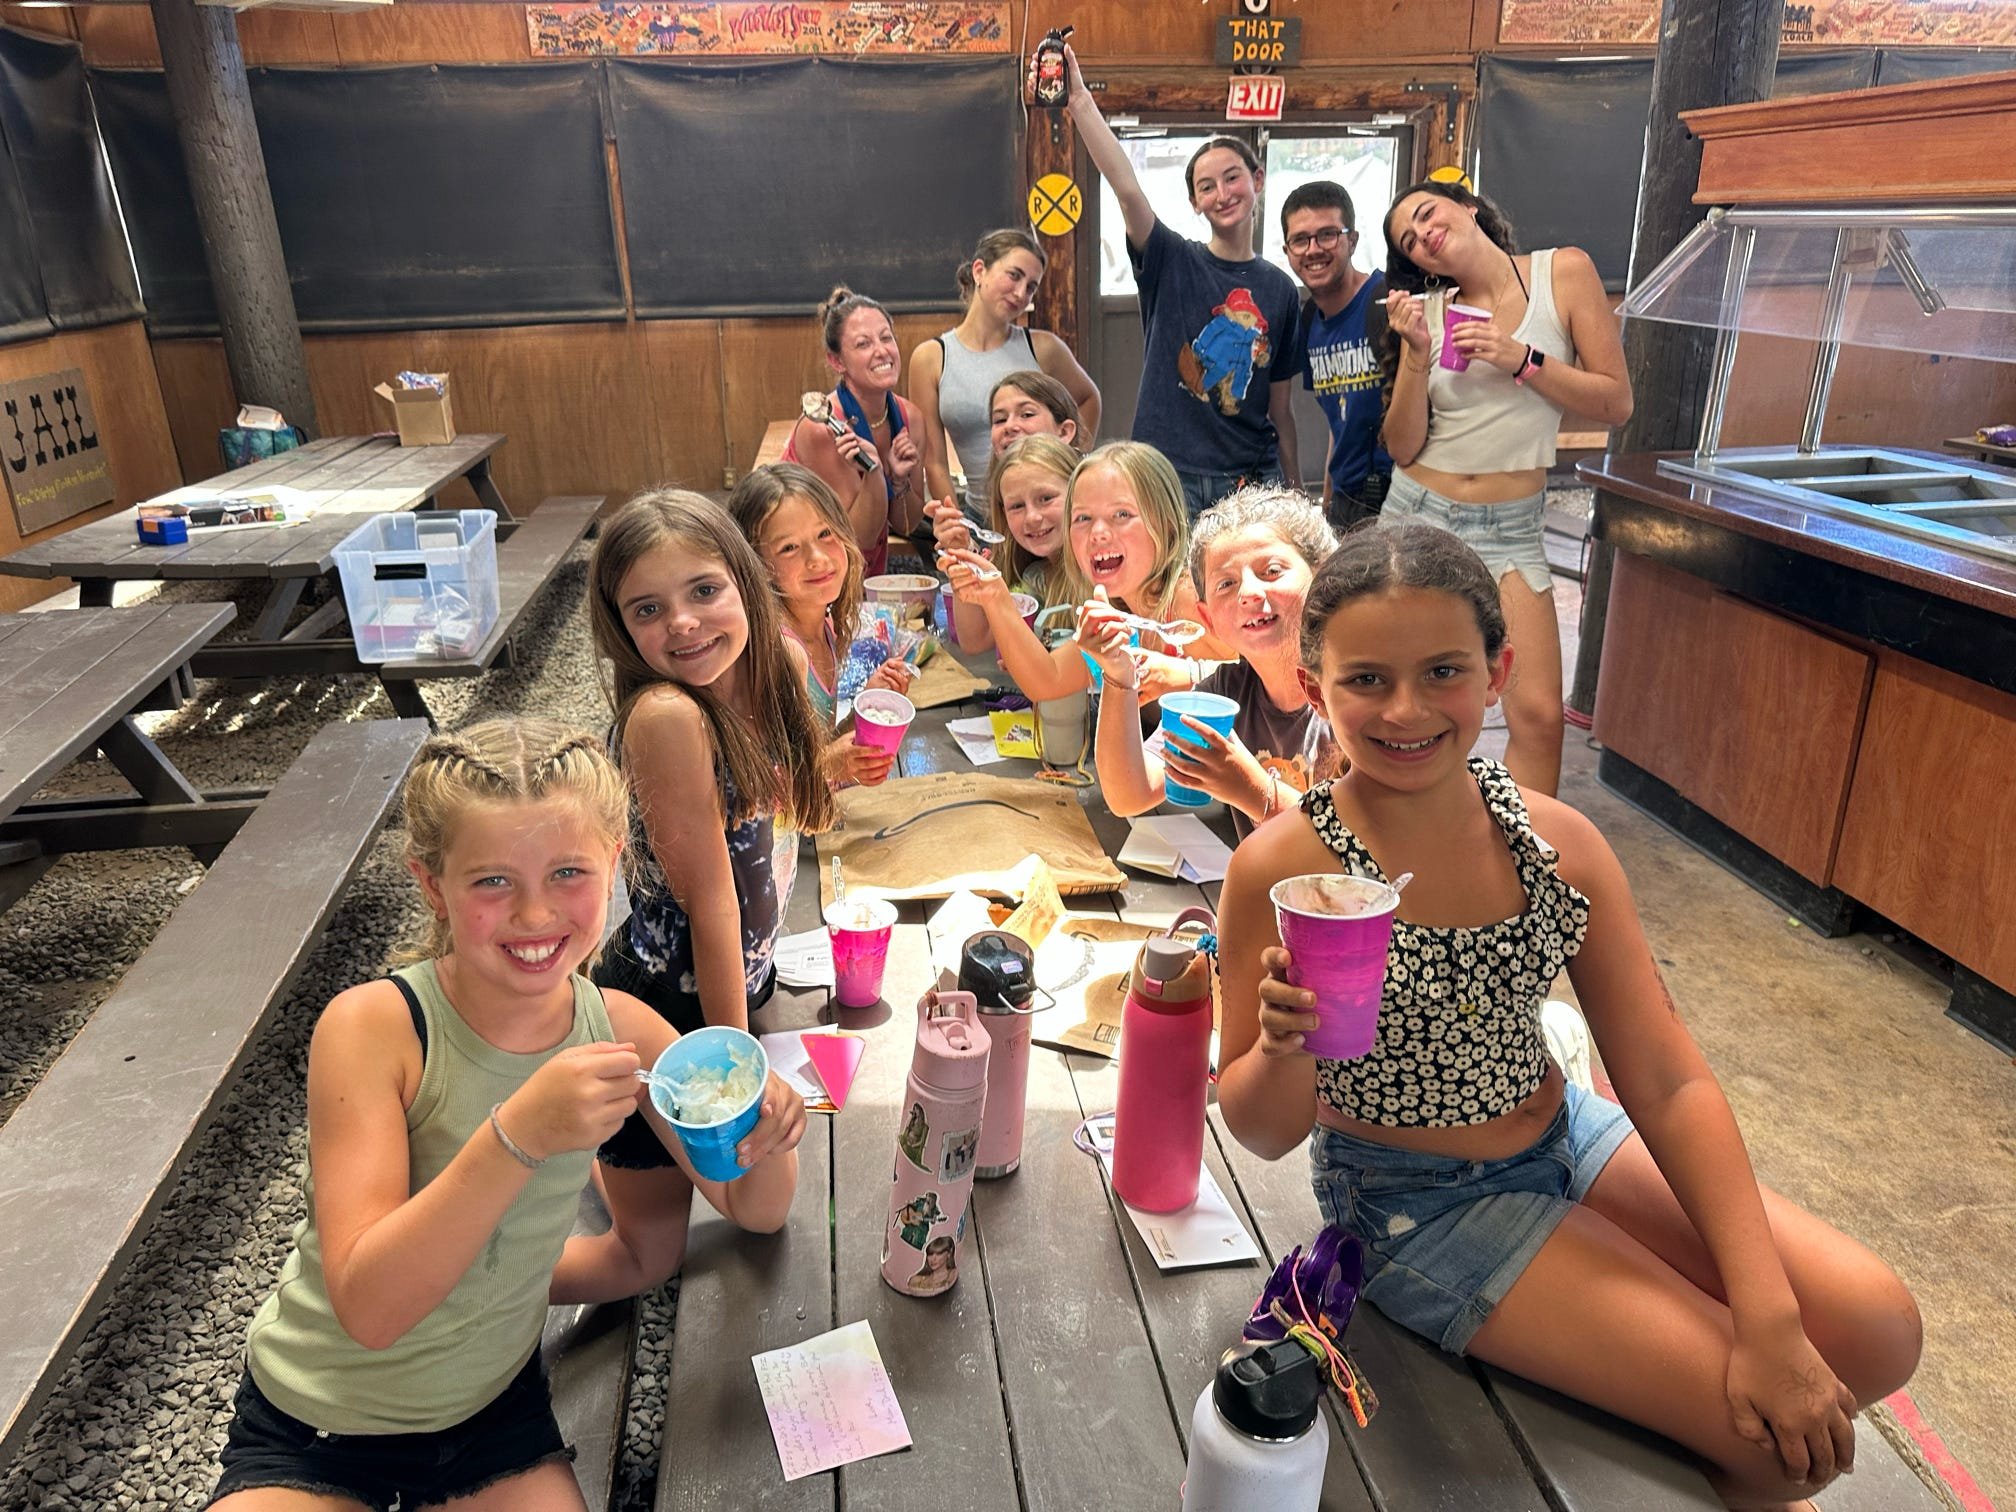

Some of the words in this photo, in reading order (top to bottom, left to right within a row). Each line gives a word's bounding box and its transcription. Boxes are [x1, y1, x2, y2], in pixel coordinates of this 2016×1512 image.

[1229, 19, 1285, 39] THAT
[1780, 32, 1813, 42] COACH
[1233, 41, 1285, 61] DOOR
[1231, 81, 1281, 111] EXIT
[1034, 196, 1043, 214] R
[1069, 194, 1079, 212] R
[5, 385, 98, 473] JAIL
